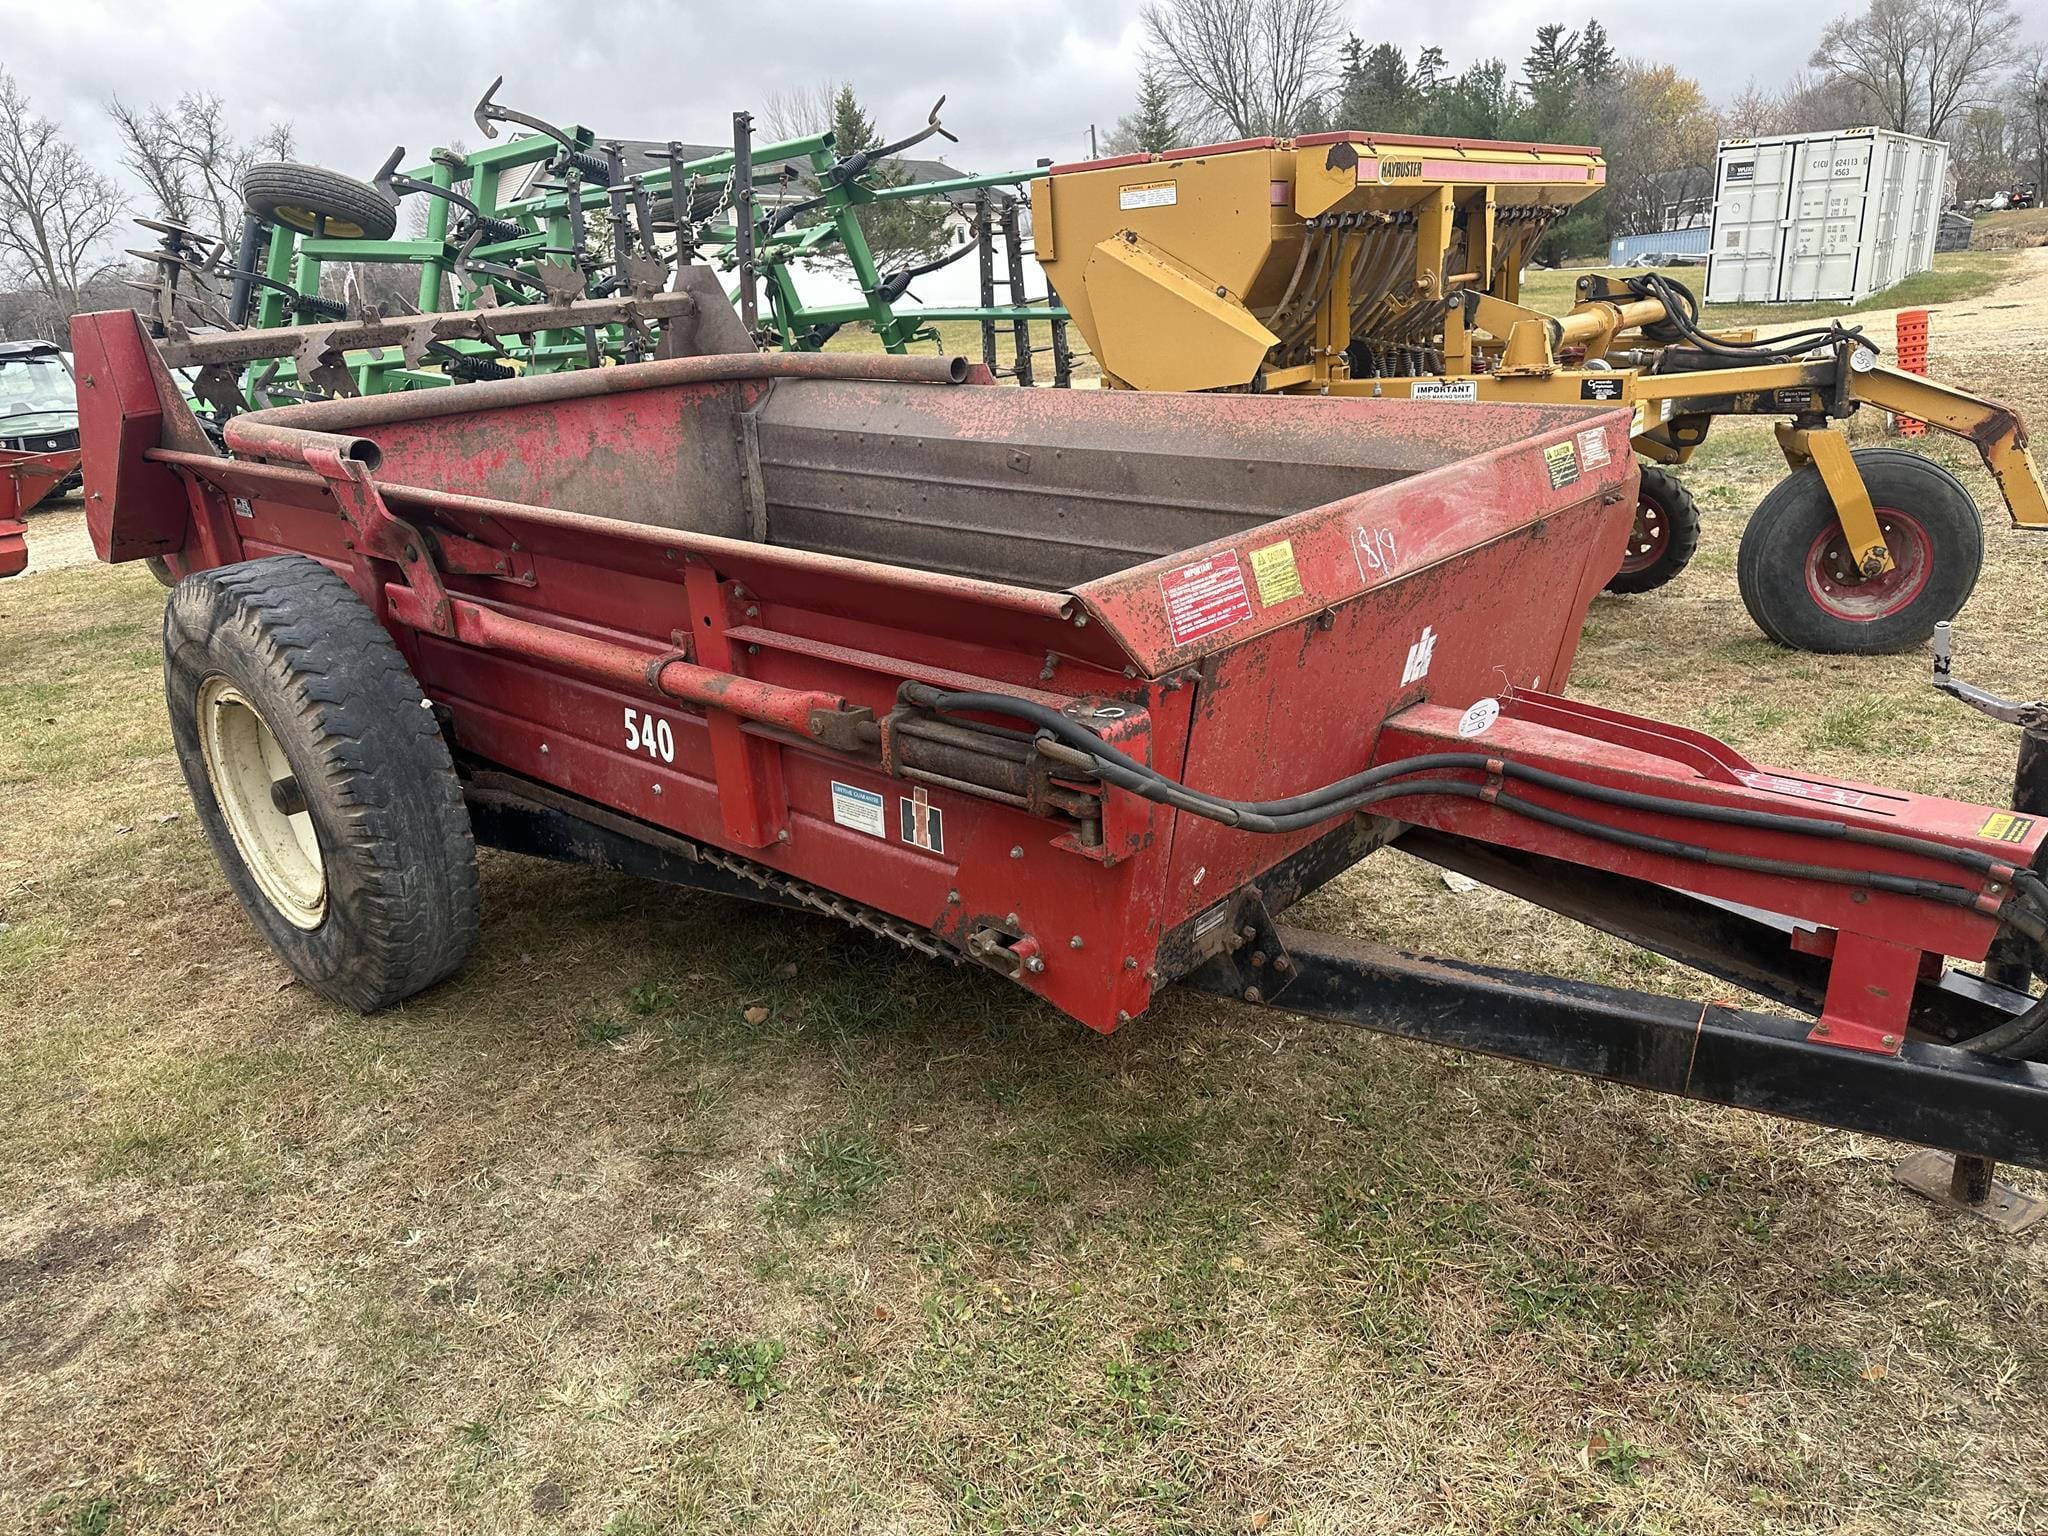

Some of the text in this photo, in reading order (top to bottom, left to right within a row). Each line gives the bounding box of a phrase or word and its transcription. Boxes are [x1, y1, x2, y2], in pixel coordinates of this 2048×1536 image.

[1381, 161, 1423, 178] HAYBUSTER
[1834, 168, 1849, 176] 45G3
[1417, 385, 1471, 394] IMPORTANT
[1351, 526, 1398, 583] 1819
[1467, 704, 1489, 733] 1819
[624, 707, 675, 763] 540
